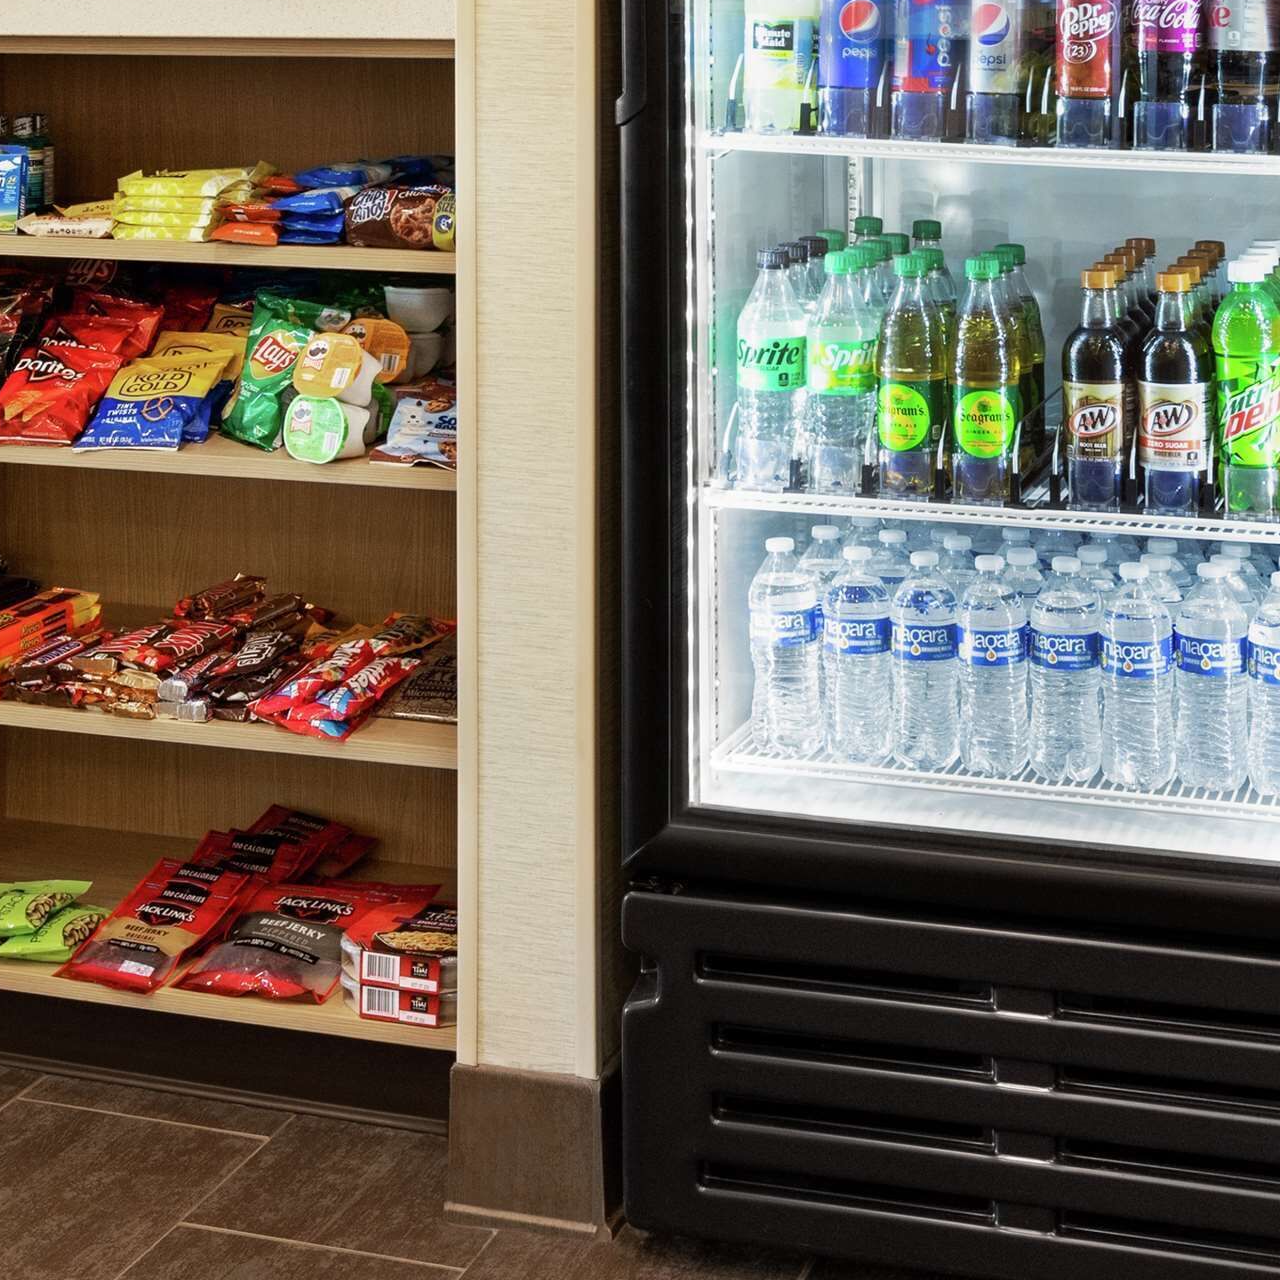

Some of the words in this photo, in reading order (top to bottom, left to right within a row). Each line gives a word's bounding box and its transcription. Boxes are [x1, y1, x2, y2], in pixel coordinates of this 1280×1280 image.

[1078, 2, 1102, 21] Dr
[1061, 7, 1115, 39] Pepper
[936, 5, 952, 67] pepsi
[1071, 45, 1085, 57] 23
[352, 189, 387, 208] CHIPS
[253, 337, 296, 371] Lay's
[736, 338, 801, 369] Sprite
[821, 340, 878, 371] Sprit
[14, 358, 87, 381] Doritos
[133, 372, 186, 383] ROLD
[126, 381, 179, 393] GOLD
[107, 408, 138, 416] TWISTS
[116, 402, 135, 410] TINY
[960, 409, 1011, 425] Seagram's
[1146, 440, 1164, 449] ZERO
[1164, 440, 1189, 450] SUGAR
[1031, 631, 1087, 656] niagara
[1103, 639, 1163, 664] niagara
[1180, 638, 1240, 663] niagara
[135, 903, 162, 916] JACK
[161, 906, 196, 923] LINK'S
[274, 895, 310, 908] JACK
[310, 898, 354, 916] LINK'S
[124, 923, 145, 933] BEEF
[145, 927, 170, 937] JERKY
[259, 917, 288, 929] BEEF
[287, 922, 326, 941] JERKY
